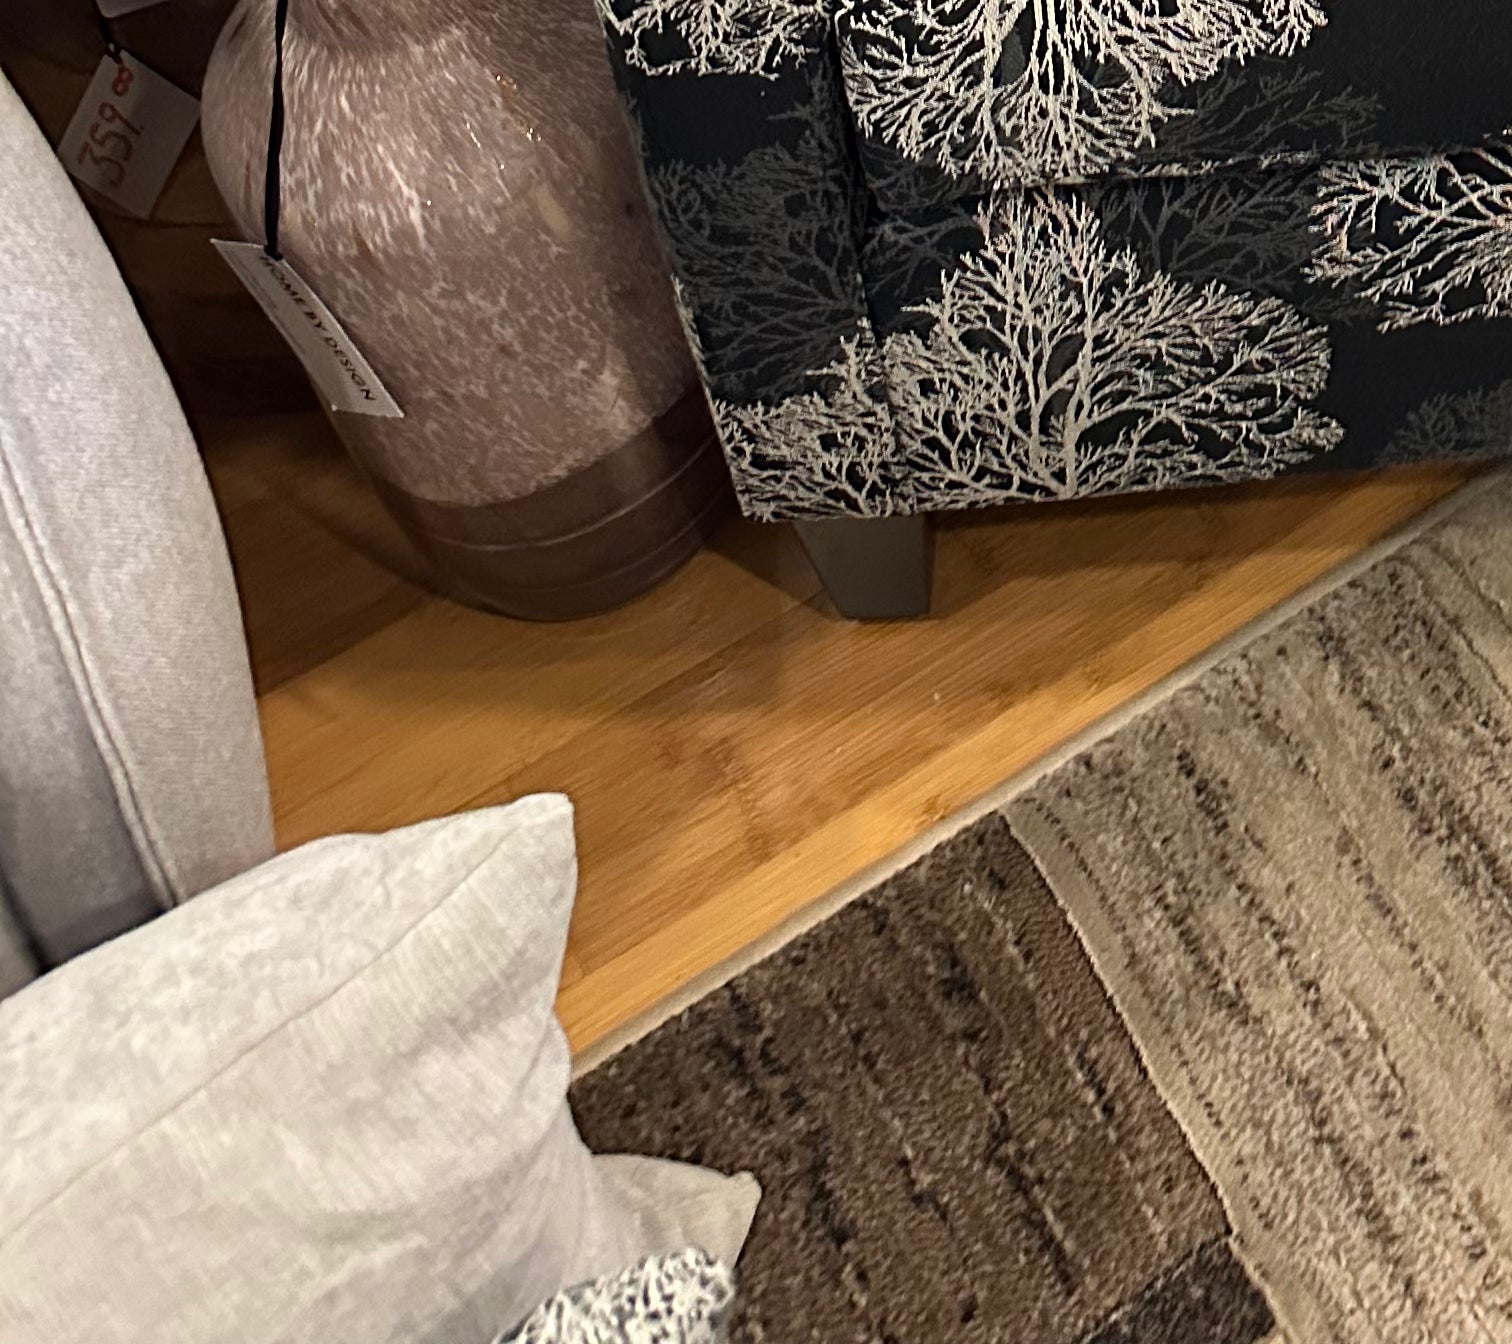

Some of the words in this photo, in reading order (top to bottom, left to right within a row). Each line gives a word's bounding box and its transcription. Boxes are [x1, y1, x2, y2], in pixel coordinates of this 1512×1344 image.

[259, 255, 307, 307] HOME
[304, 311, 328, 332] BY
[323, 336, 378, 402] DESIGN
